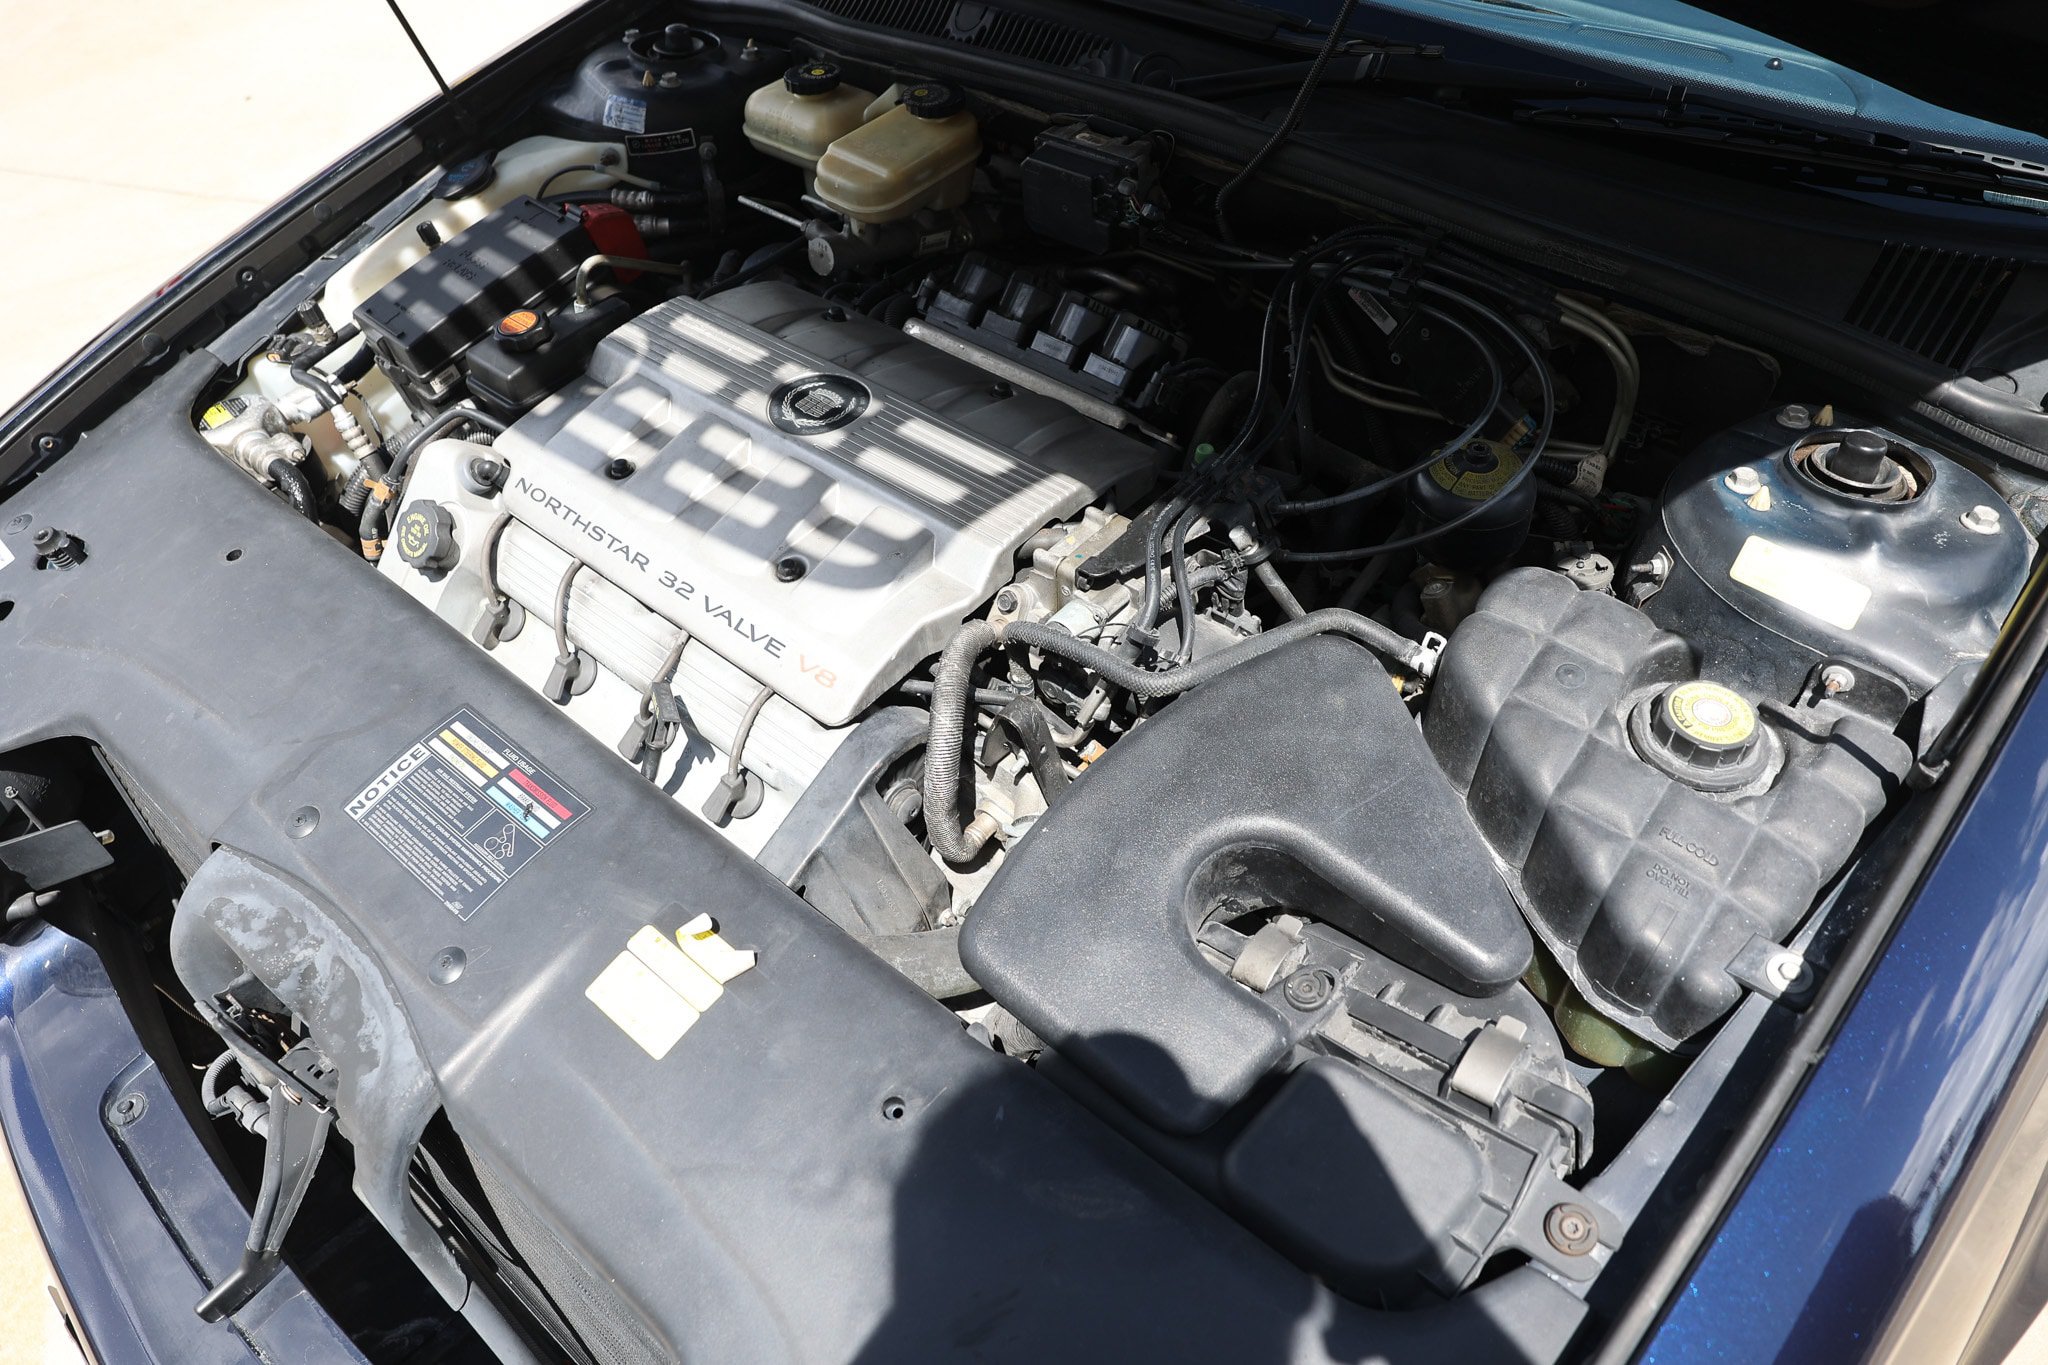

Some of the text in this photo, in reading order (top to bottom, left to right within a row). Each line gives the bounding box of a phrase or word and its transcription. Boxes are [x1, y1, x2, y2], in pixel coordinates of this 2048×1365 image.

[514, 476, 839, 689] NORTHSTAR 32 VALVE V8
[502, 747, 536, 775] FLUID USAGE
[347, 746, 426, 816] NOTICE
[1659, 826, 1719, 867] FULL COLD
[1646, 869, 1690, 900] OVER FILL
[1653, 863, 1691, 889] DO NOT
